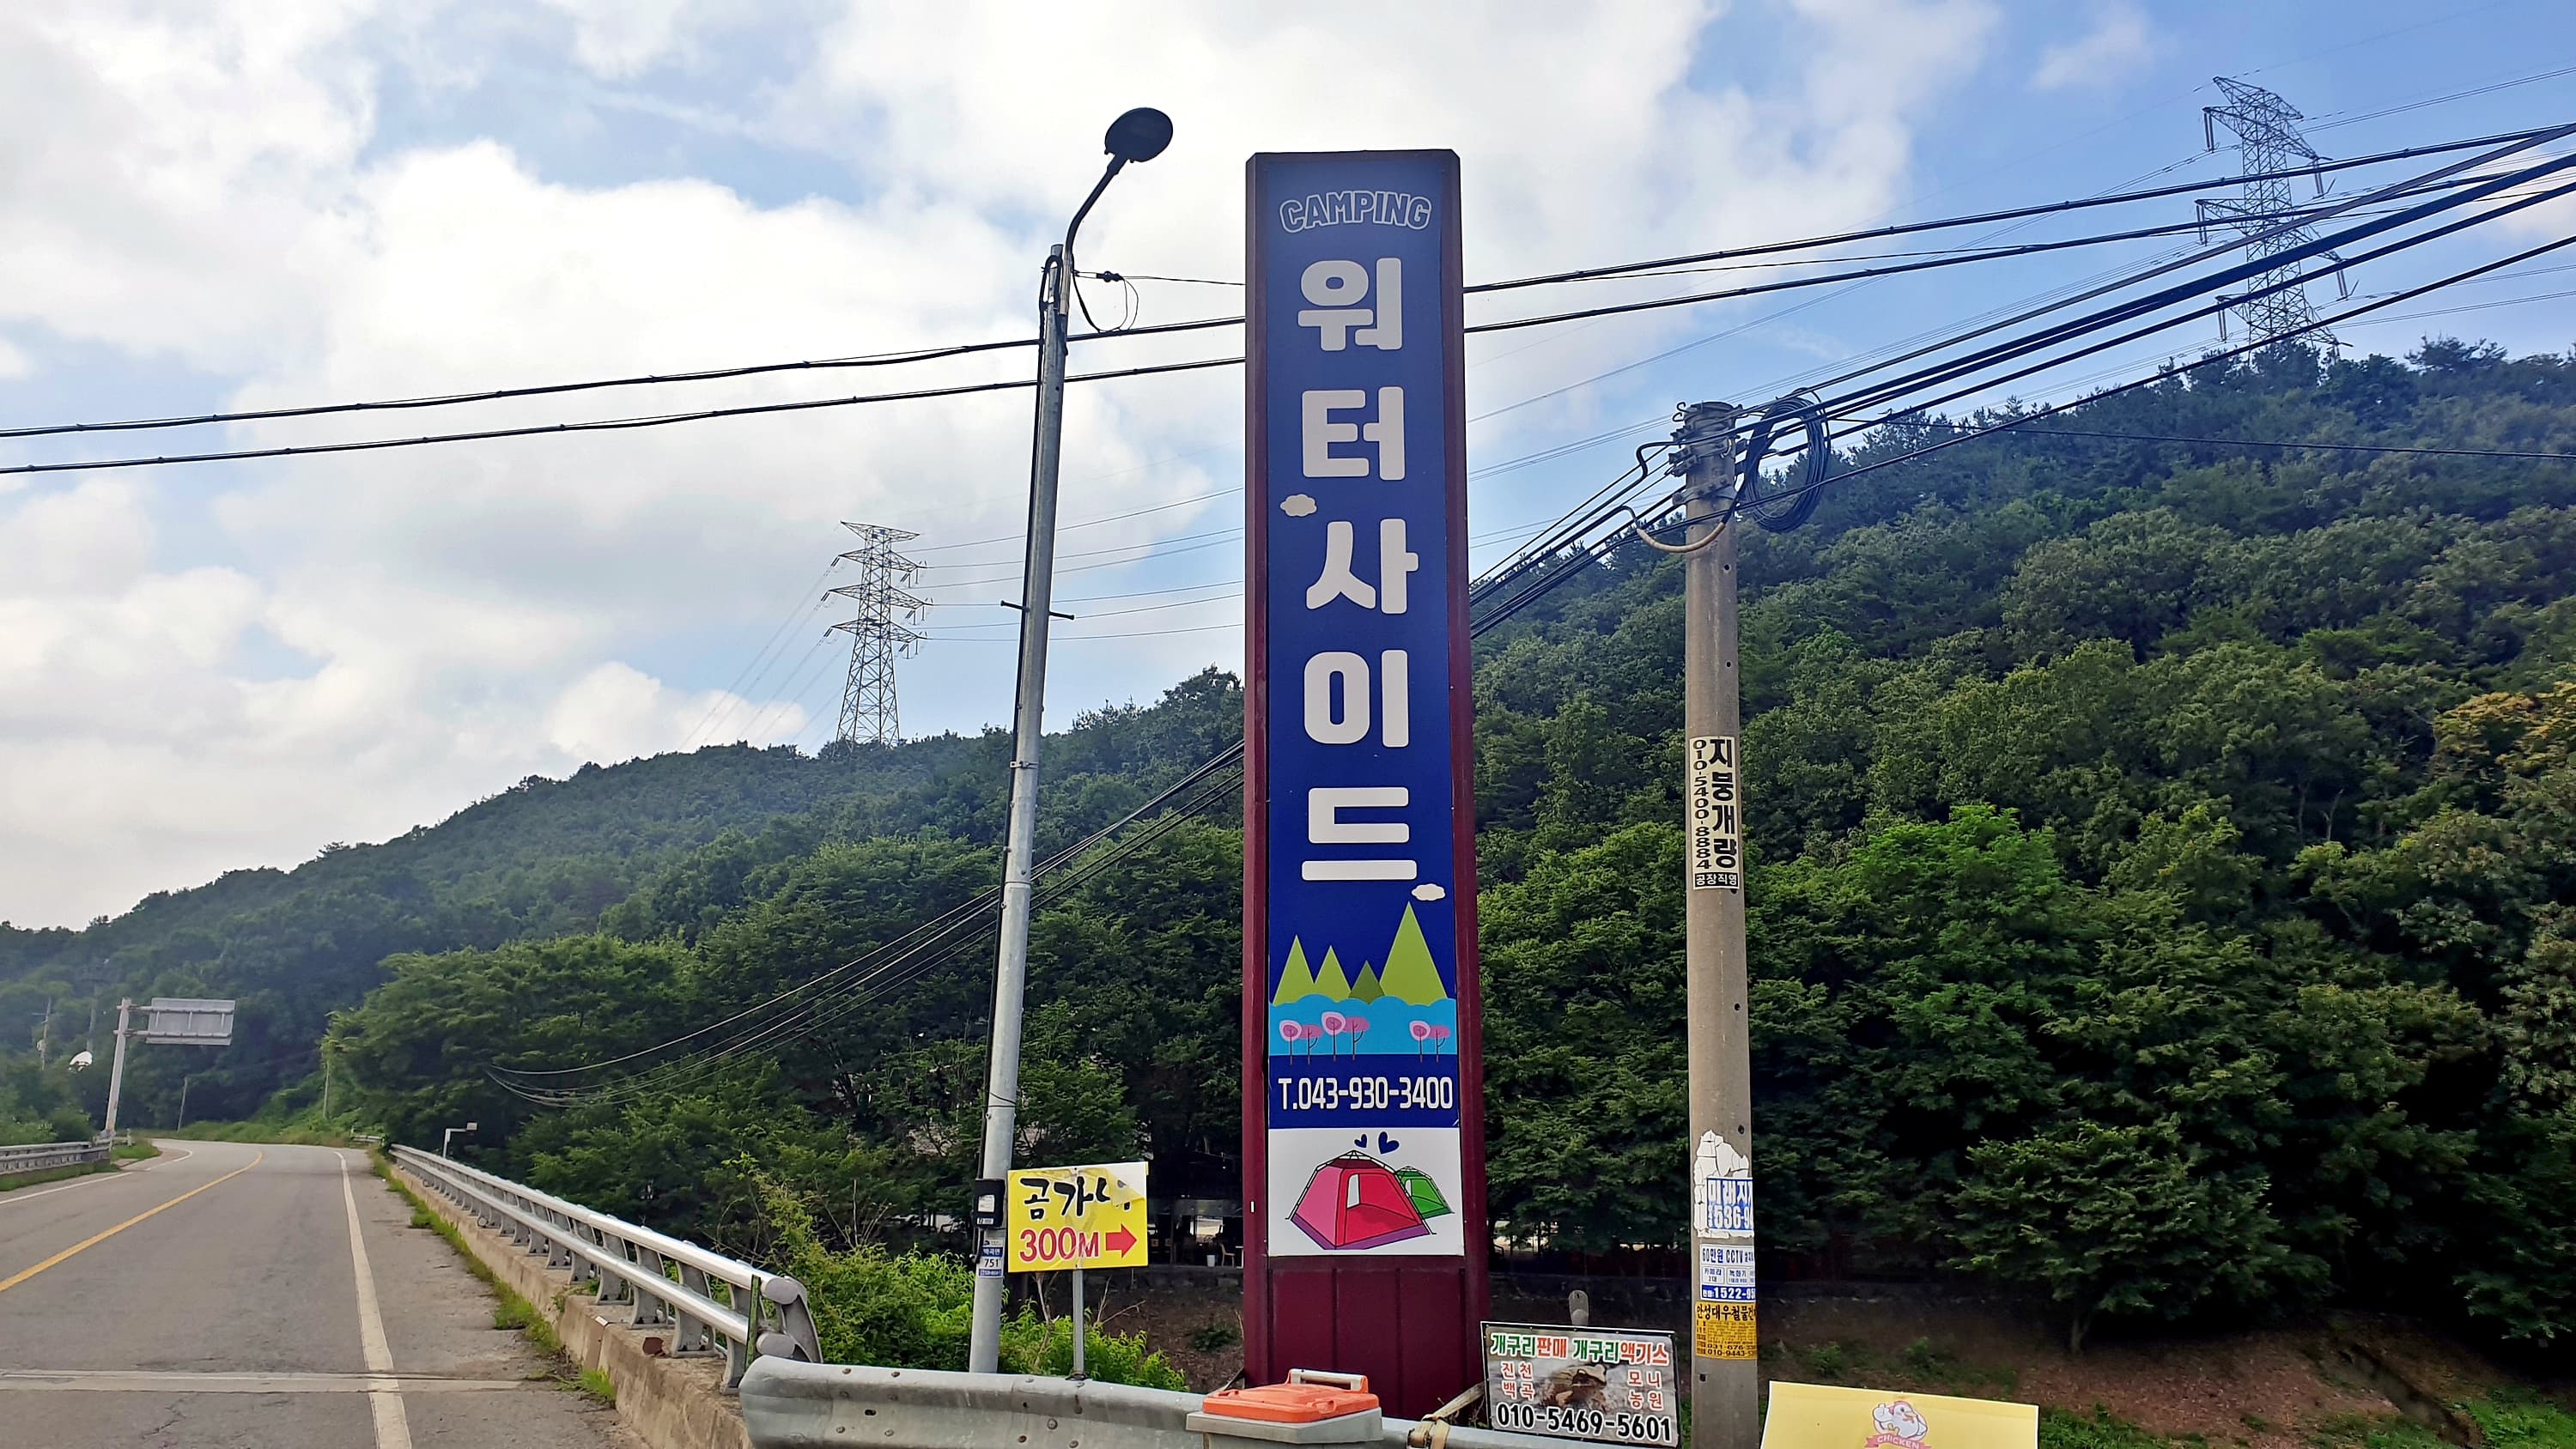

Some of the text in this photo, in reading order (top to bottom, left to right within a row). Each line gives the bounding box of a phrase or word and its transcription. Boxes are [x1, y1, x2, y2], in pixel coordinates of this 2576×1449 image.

[1279, 191, 1431, 233] CAMPING
[1297, 258, 1419, 881] 워터사이드
[1693, 739, 1711, 870] 010-5400-8884
[1695, 873, 1738, 886] 공장직영
[1278, 1076, 1453, 1110] T.043-930-3400
[984, 1258, 999, 1268] 751
[1703, 1247, 1723, 1264] 60만원
[1726, 1249, 1743, 1264] CCTV
[1696, 1304, 1756, 1321] 안성대우철물건
[1491, 1333, 1669, 1367] 개구리판매 개구리액기스
[1502, 1361, 1534, 1380] 진천
[1628, 1370, 1662, 1389] 모니
[1503, 1382, 1535, 1401] 백곡
[1628, 1391, 1663, 1410] 농원
[1497, 1404, 1672, 1442] 010-5469-5601
[1876, 1434, 1920, 1449] CHICKEN
